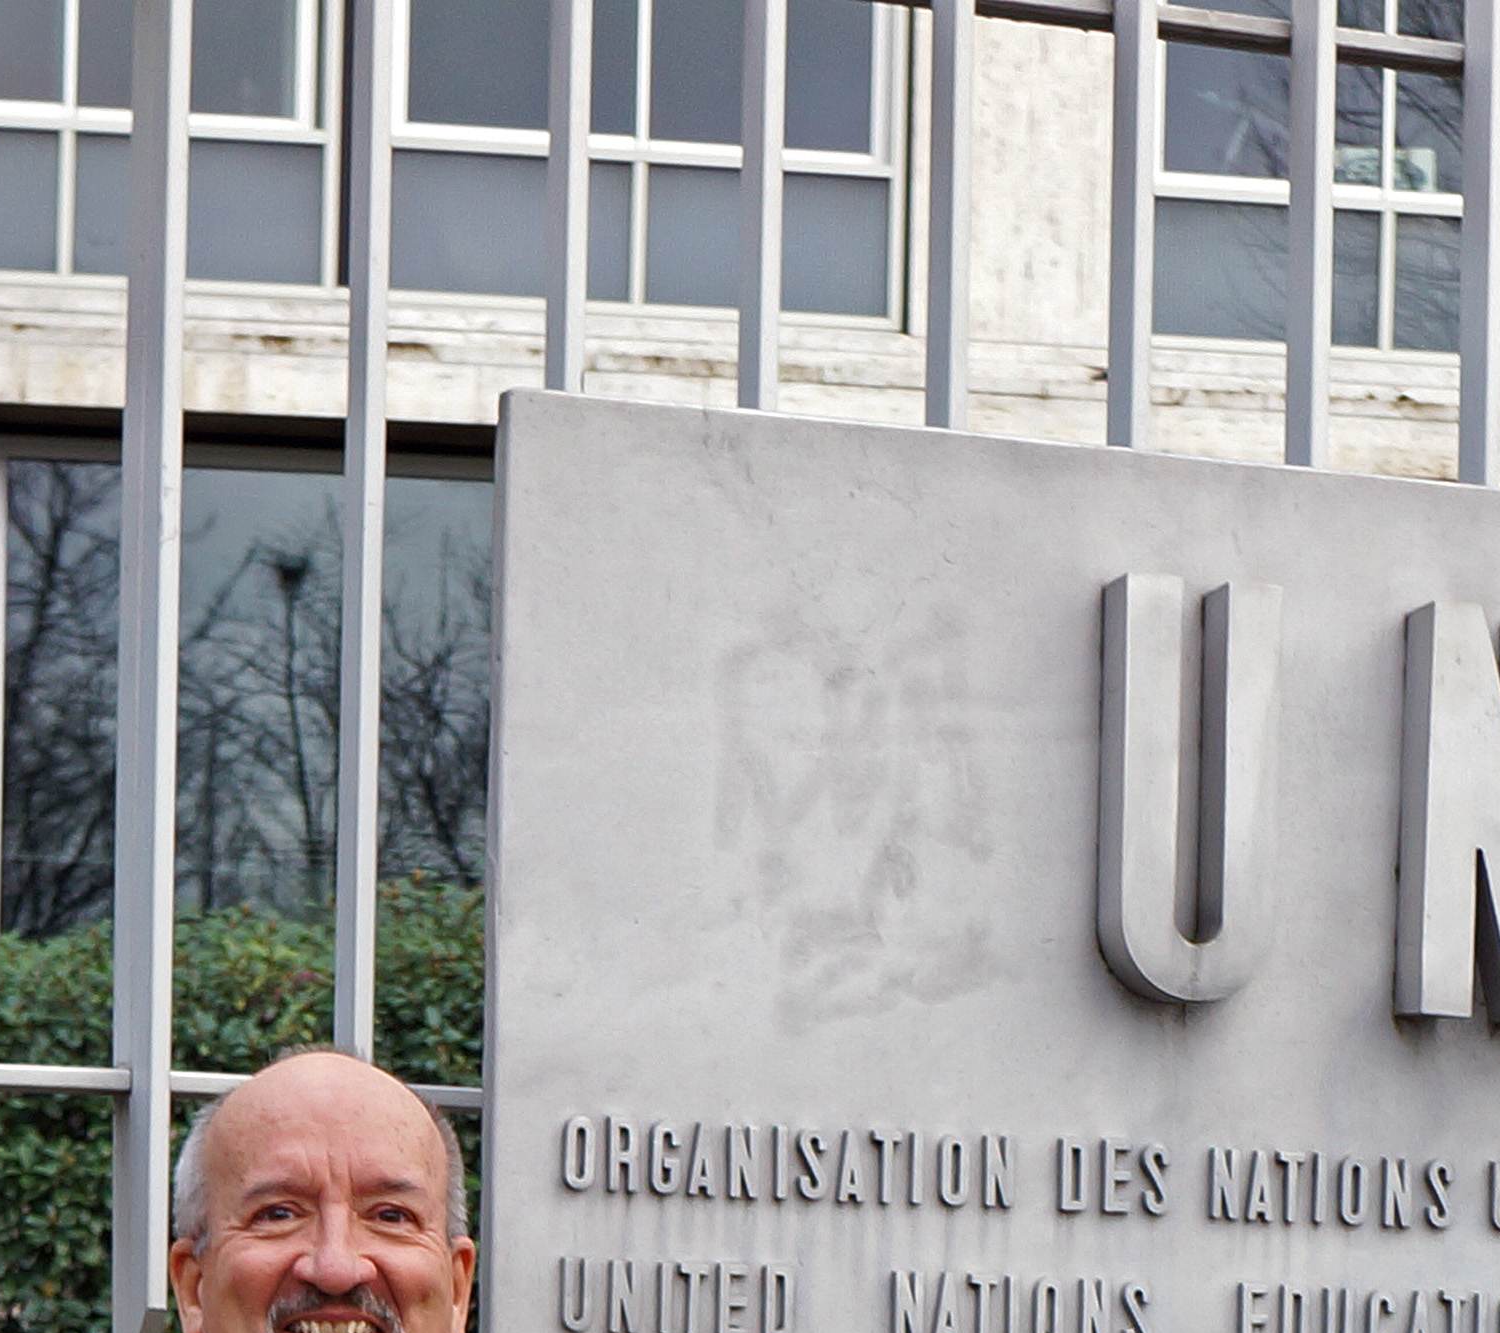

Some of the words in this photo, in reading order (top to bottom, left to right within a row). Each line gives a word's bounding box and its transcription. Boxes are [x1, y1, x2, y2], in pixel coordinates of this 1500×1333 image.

[560, 1112, 1014, 1210] ORGANISATION
[1056, 1136, 1171, 1217] DES
[1209, 1143, 1456, 1230] NATIONS
